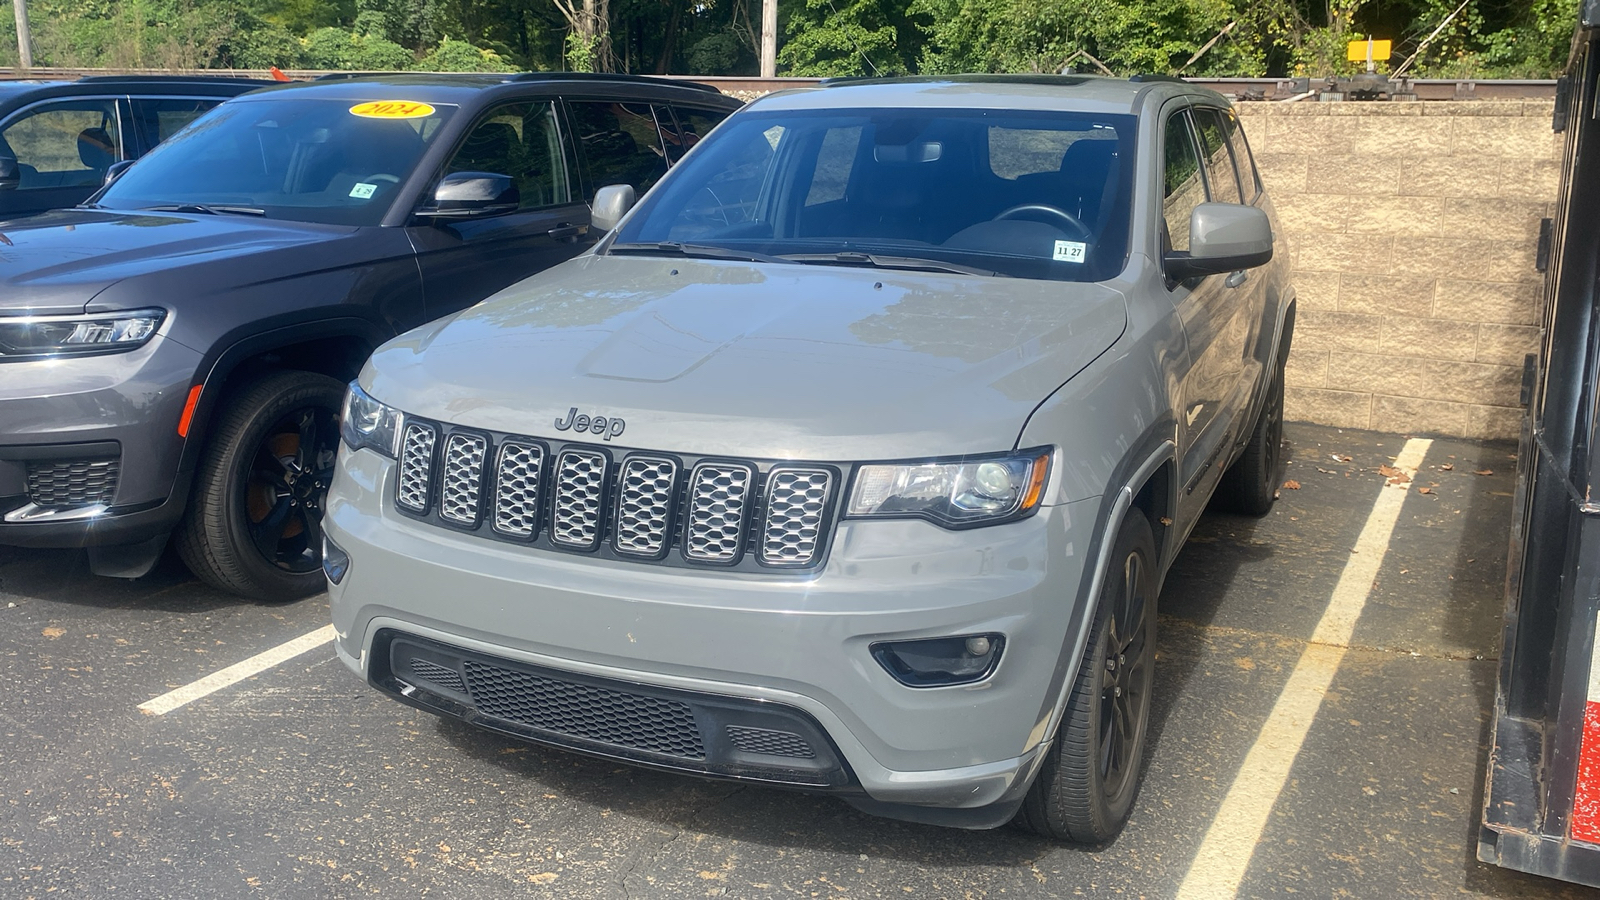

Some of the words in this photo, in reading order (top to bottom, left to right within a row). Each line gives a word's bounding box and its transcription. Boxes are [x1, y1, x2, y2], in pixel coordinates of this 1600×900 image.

[359, 103, 423, 115] 2024
[1057, 246, 1069, 256] 11
[1070, 247, 1082, 257] 27
[554, 407, 626, 441] Jeep
